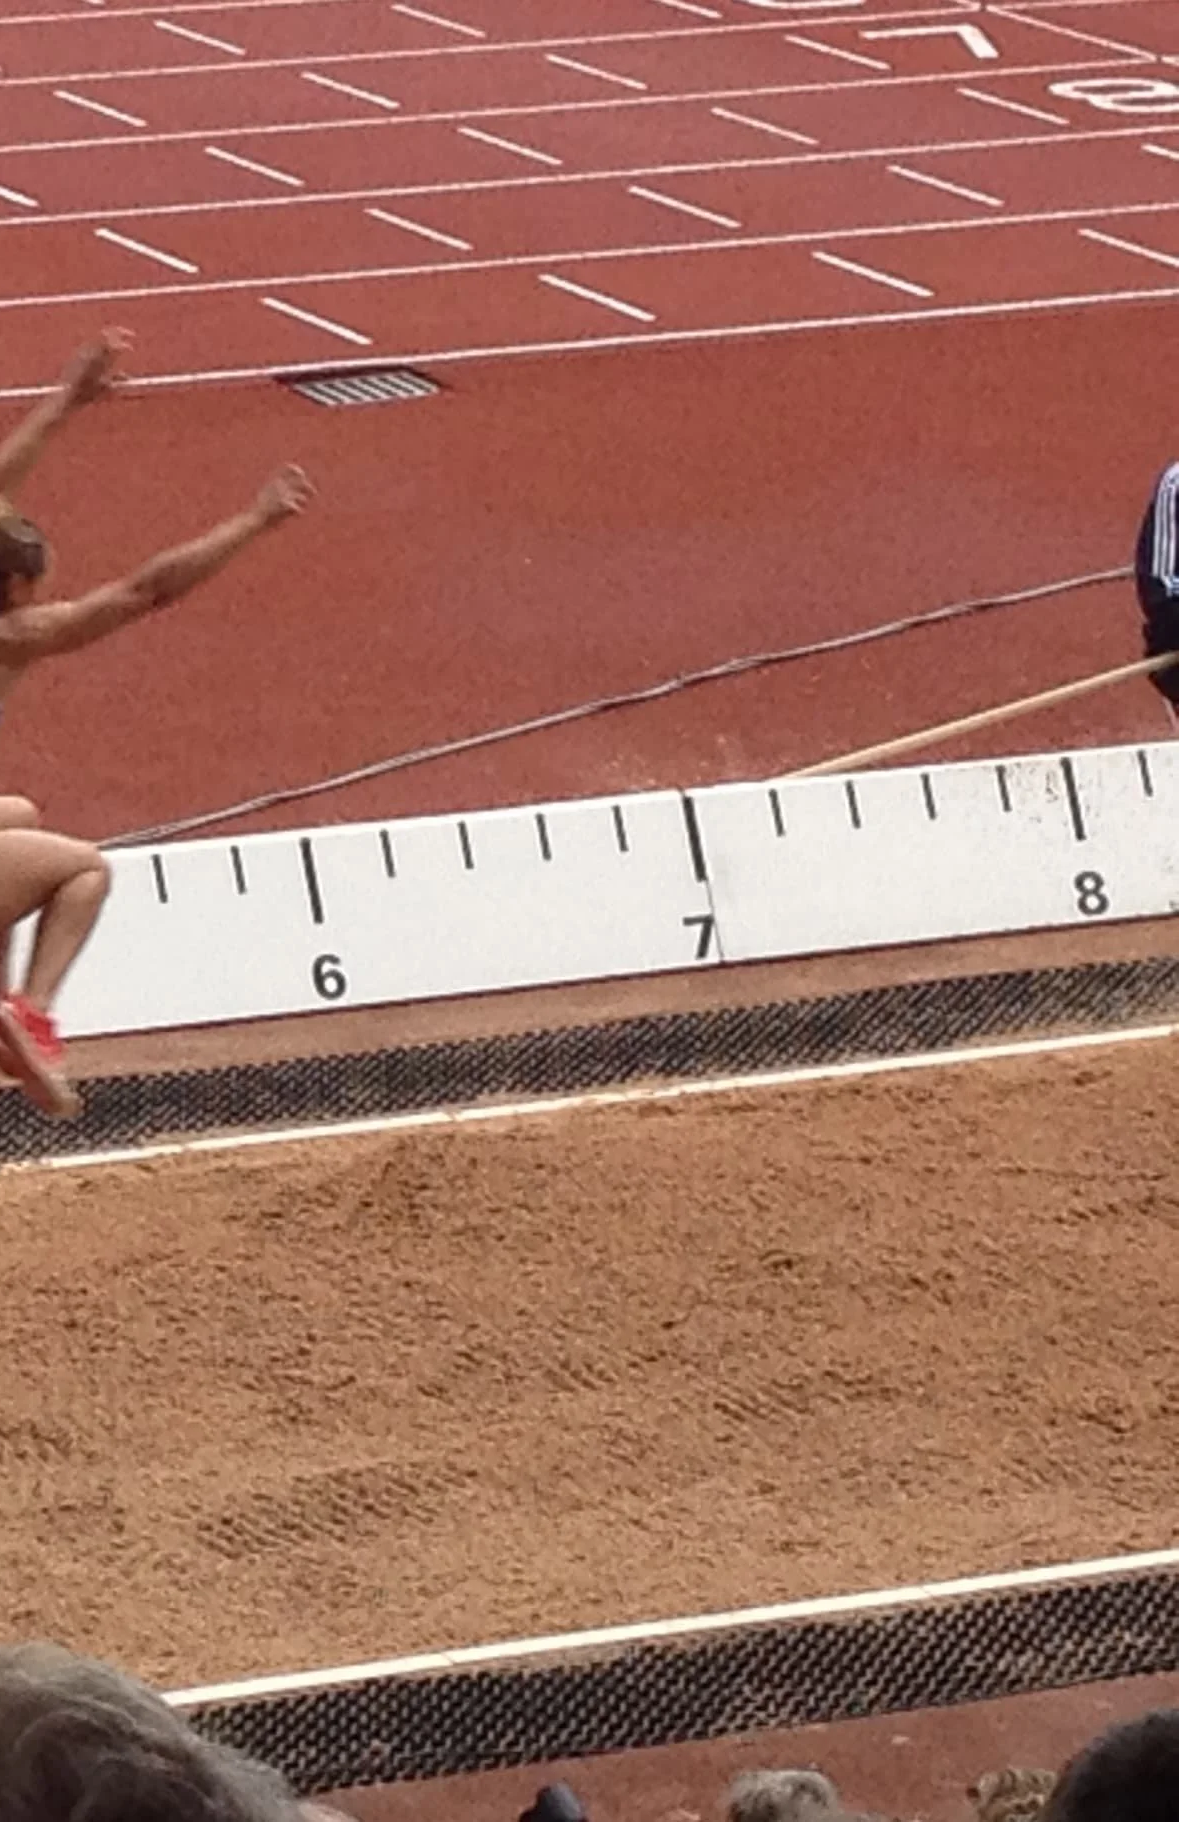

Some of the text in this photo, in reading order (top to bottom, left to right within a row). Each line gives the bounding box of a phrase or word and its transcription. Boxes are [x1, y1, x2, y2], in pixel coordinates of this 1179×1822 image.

[859, 23, 999, 59] 7
[1074, 870, 1109, 916] 8
[682, 912, 715, 960] 7
[312, 953, 347, 1001] 6
